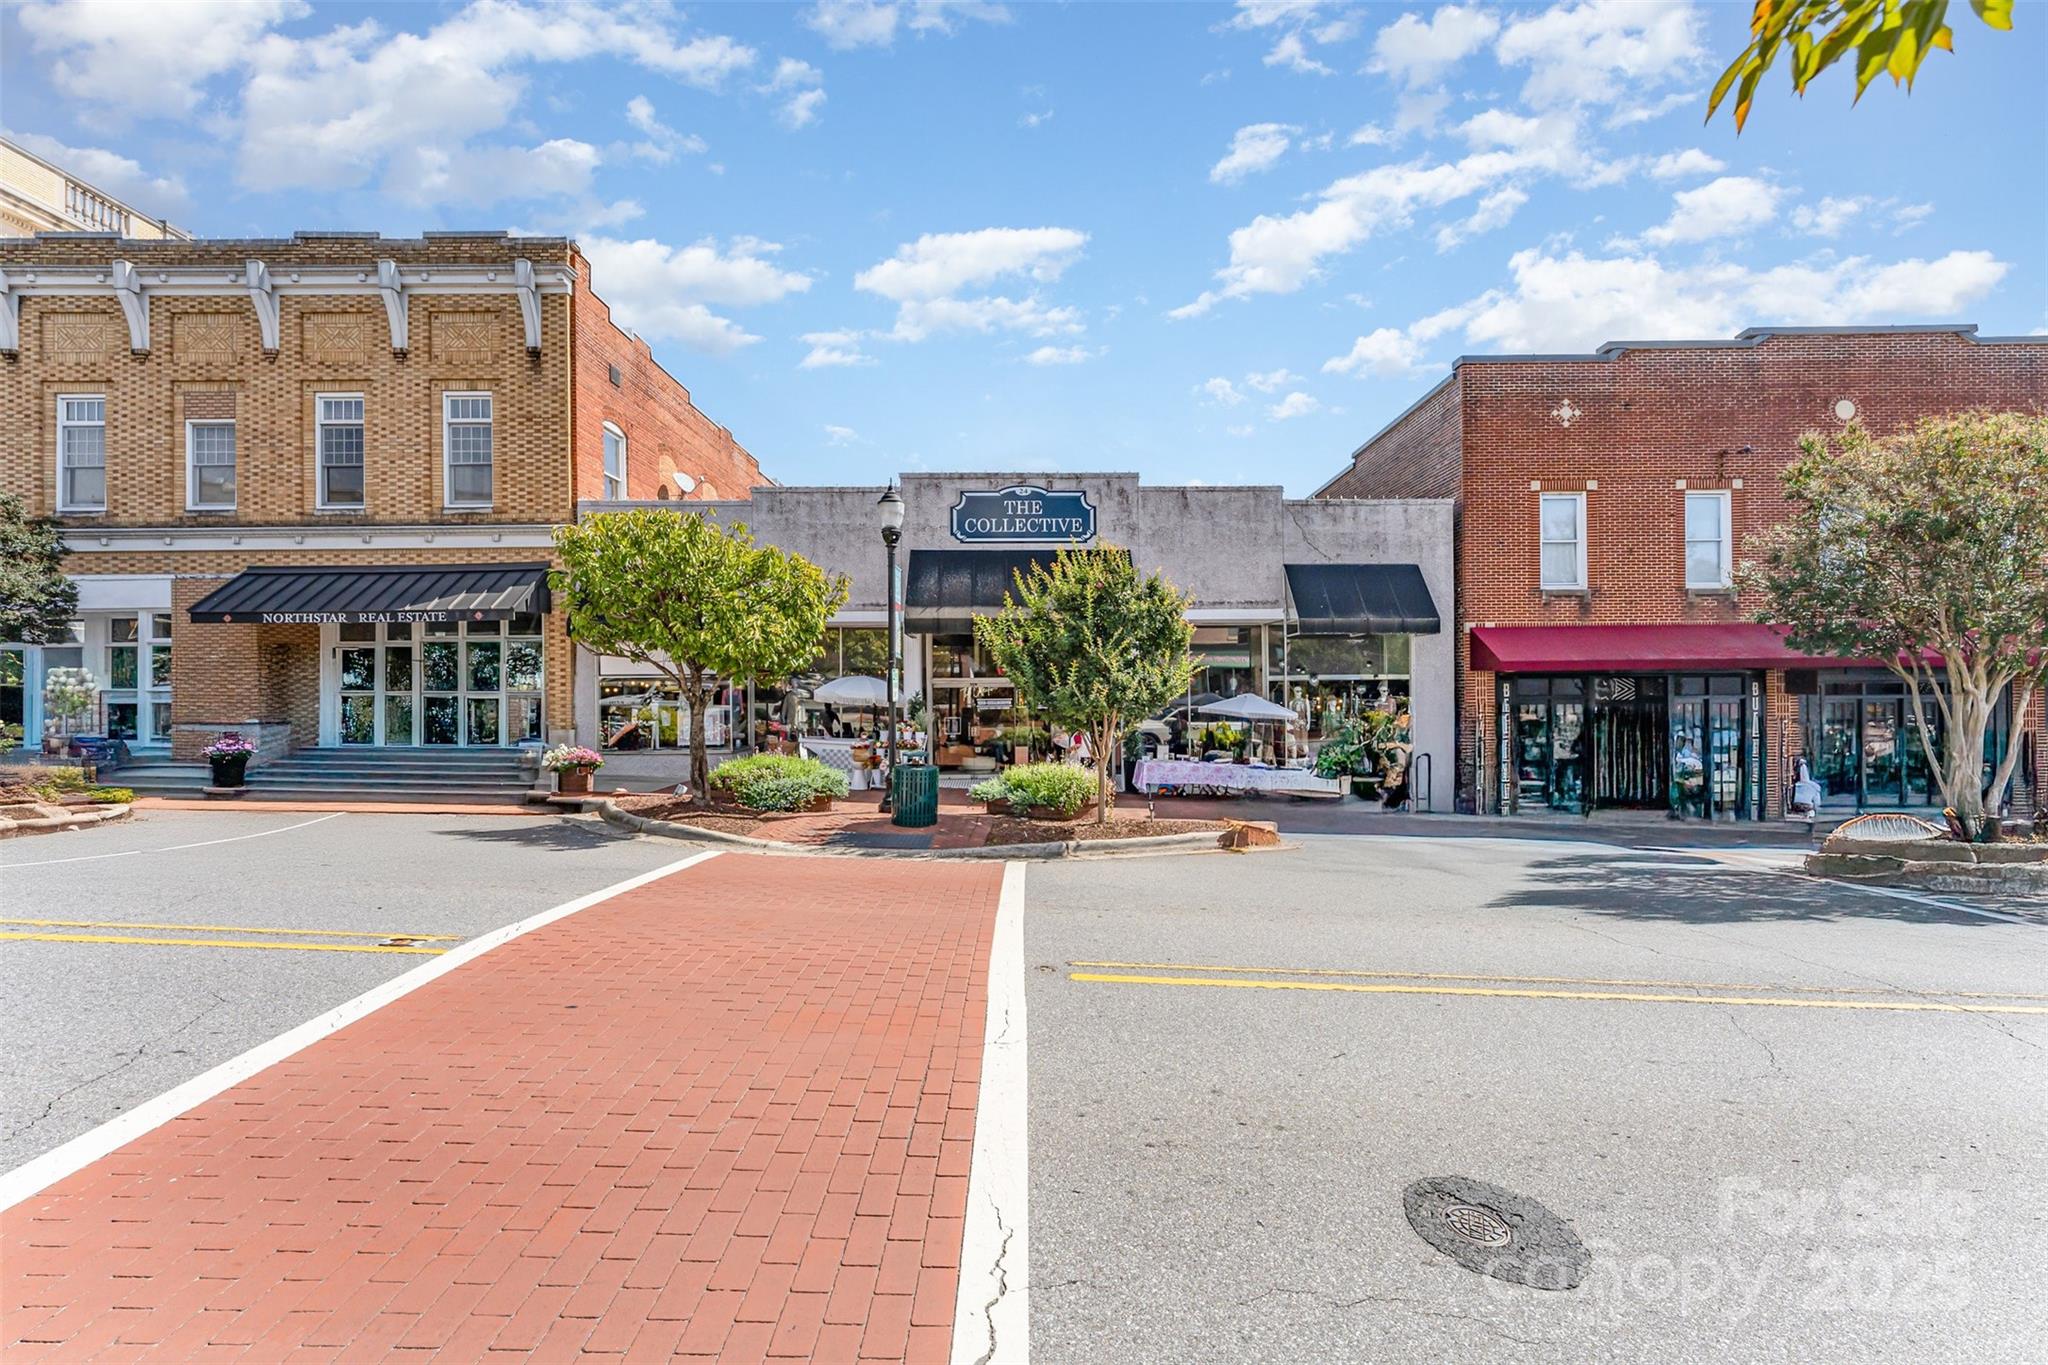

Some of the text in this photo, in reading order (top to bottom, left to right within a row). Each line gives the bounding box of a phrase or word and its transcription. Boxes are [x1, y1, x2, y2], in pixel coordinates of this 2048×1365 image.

[1003, 500, 1043, 515] THE
[964, 518, 1083, 533] COLLECTIVE
[262, 611, 447, 624] NORTHSTAR REAL ESTATE
